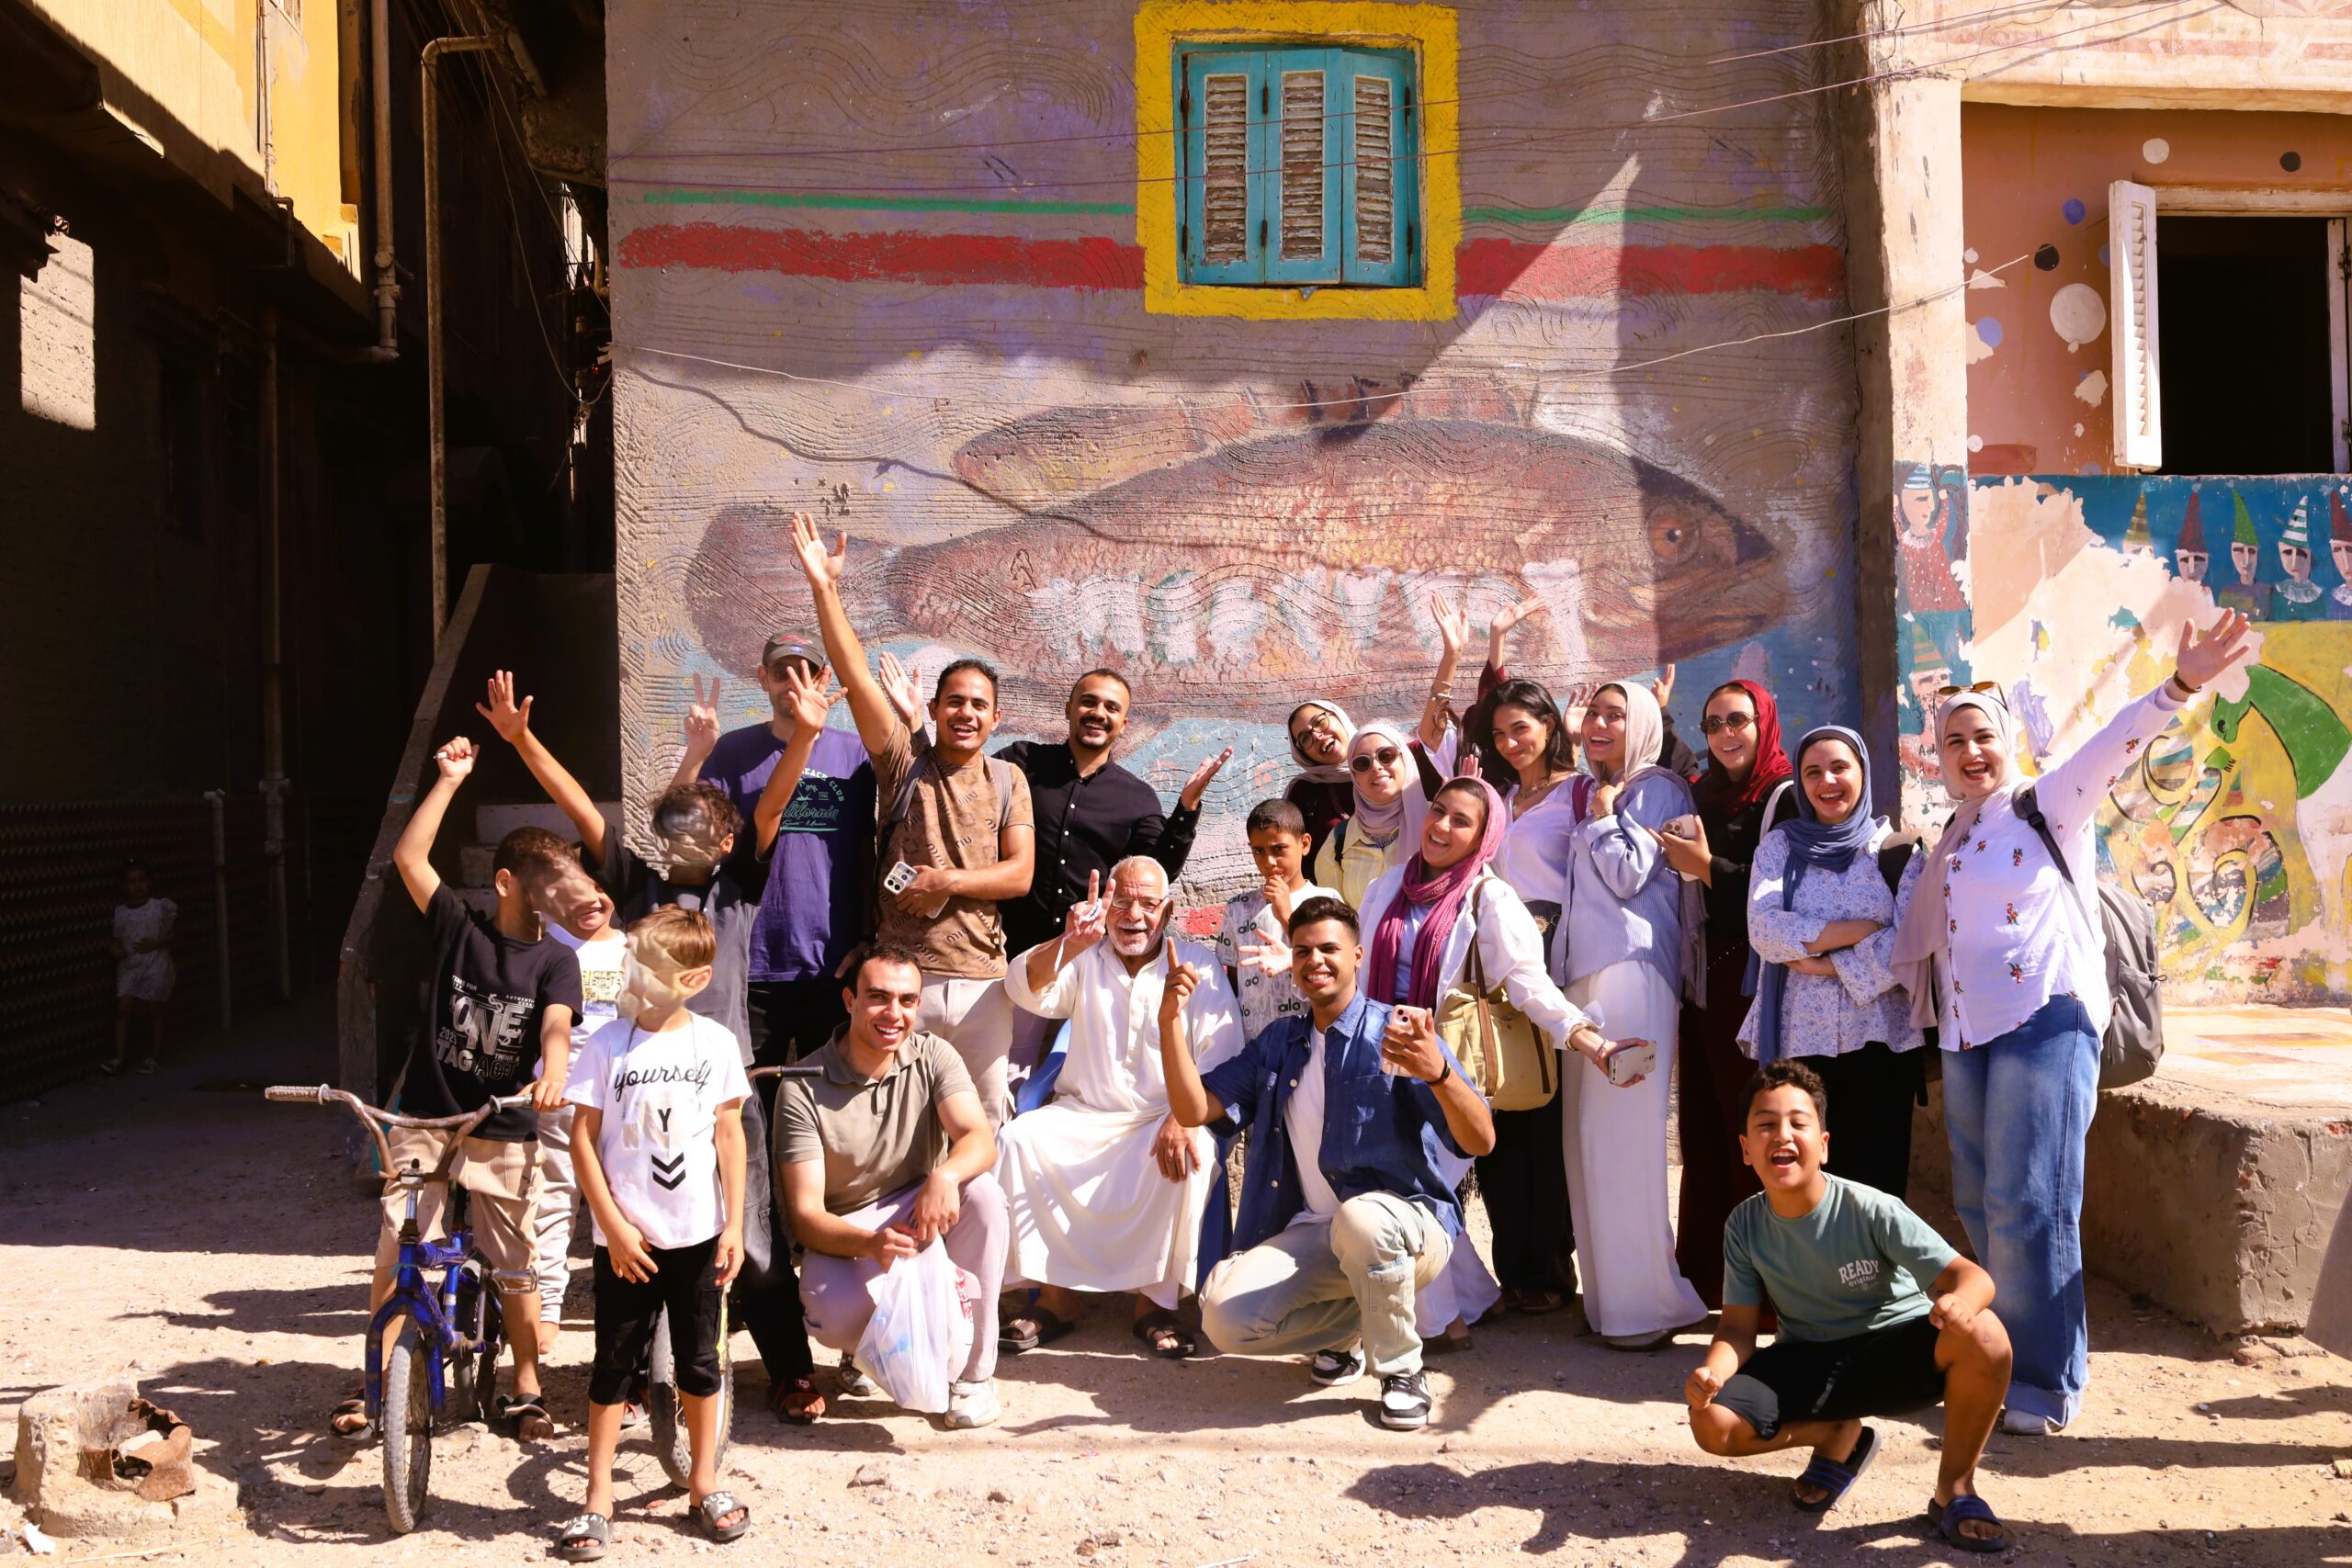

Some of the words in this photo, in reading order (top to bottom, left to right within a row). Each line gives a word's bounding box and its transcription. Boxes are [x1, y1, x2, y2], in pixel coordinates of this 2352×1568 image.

[829, 780, 845, 802] CLUB
[783, 800, 840, 822] alifornia
[1228, 894, 1250, 905] alo
[1238, 919, 1257, 934] alo
[1278, 998, 1301, 1012] alo
[437, 1038, 473, 1073] TAG
[614, 1059, 712, 1102] yourself
[657, 1107, 672, 1133] Y
[1838, 1259, 1880, 1284] READY
[1849, 1273, 1876, 1287] original
